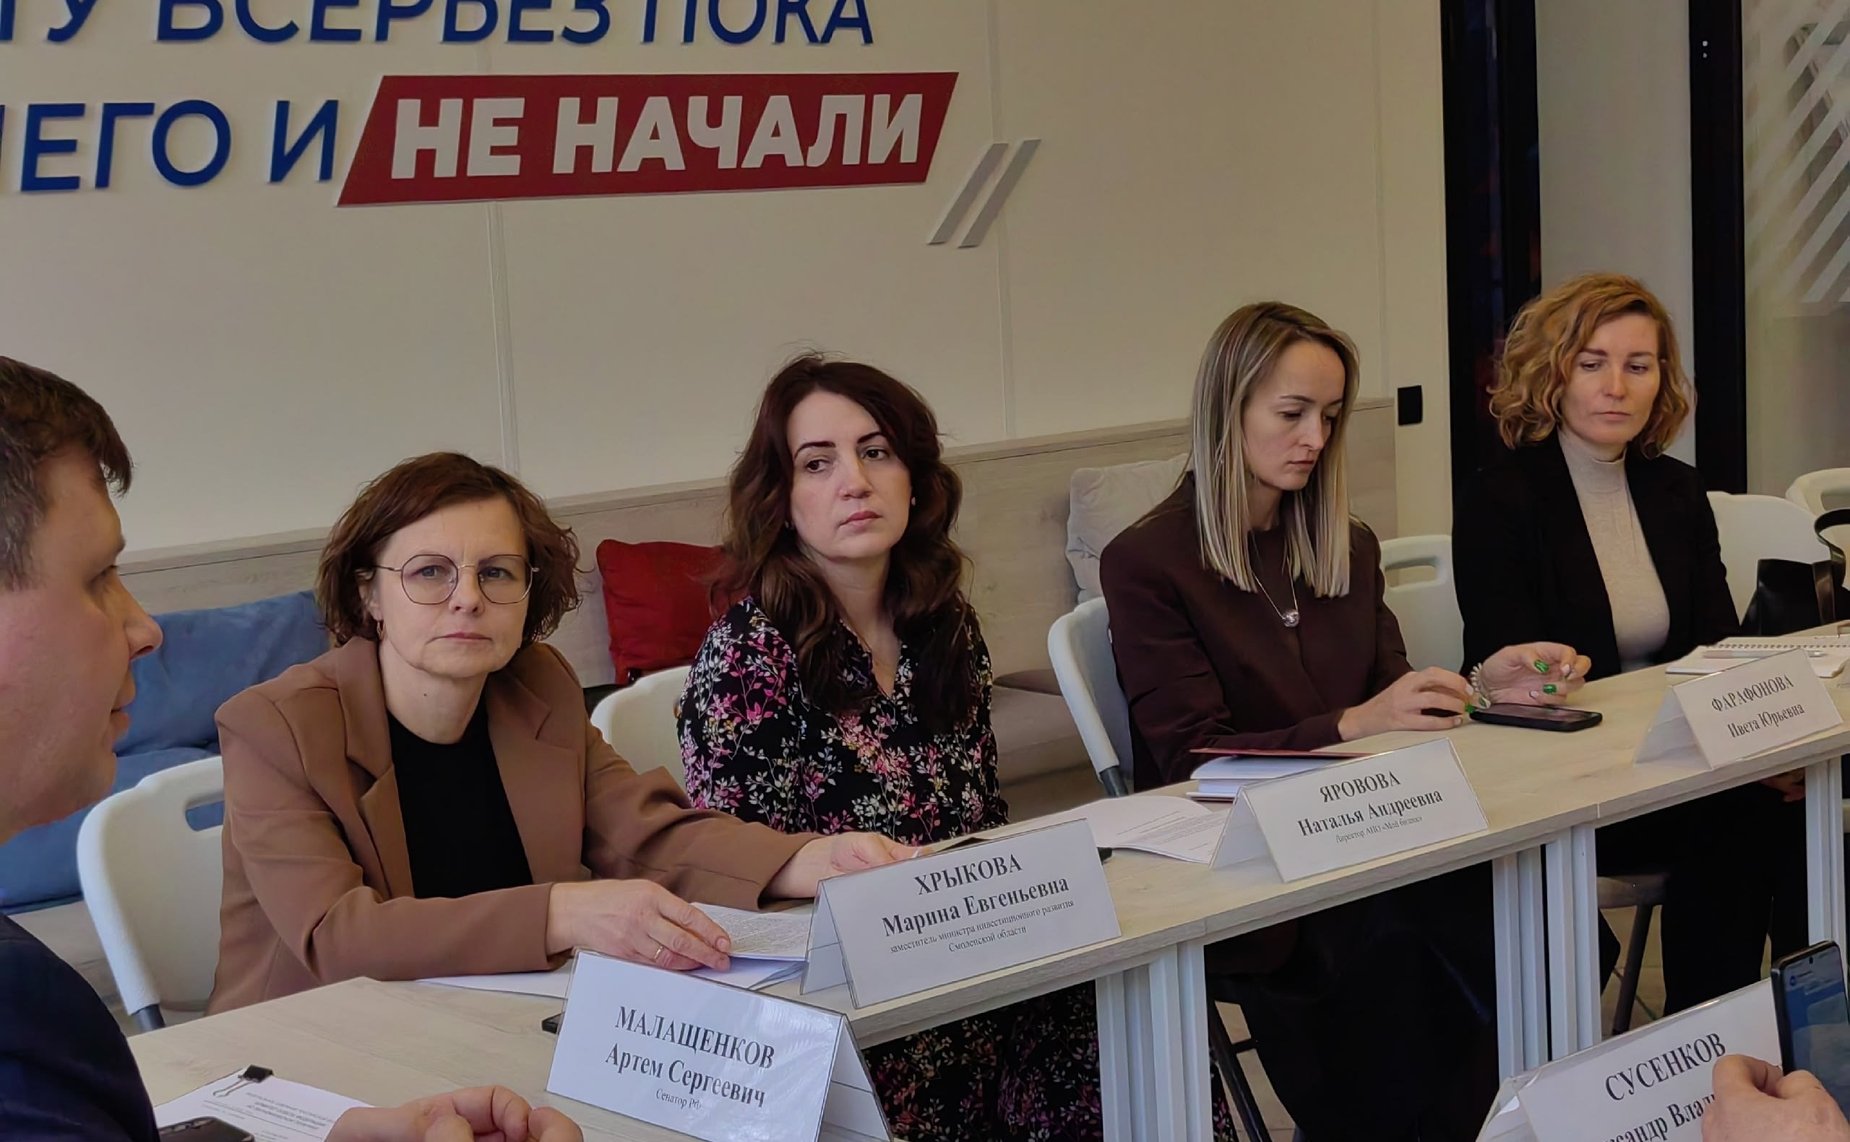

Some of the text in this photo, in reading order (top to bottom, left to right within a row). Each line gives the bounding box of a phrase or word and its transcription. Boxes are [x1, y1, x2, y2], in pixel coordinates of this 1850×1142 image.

[0, 94, 923, 191] ЕГО И НЕ НАЧАЛИ
[1711, 674, 1794, 712] ФАРАФОНОВА
[1757, 704, 1805, 727] Юрьевна
[1319, 770, 1401, 802] ЯРОВОВА
[1297, 790, 1443, 837] Наталья Андреевна
[913, 853, 1023, 896] ХРЫКОВА
[882, 878, 1070, 937] Марина Евгеньевна
[948, 925, 1027, 953] Смоленской области
[615, 1005, 775, 1069] МАЛАЩЕНКОВ
[605, 1042, 765, 1107] Артем Сергеевич
[1605, 1032, 1726, 1101] СУСЕНКОВ
[656, 1088, 688, 1109] Сенатор
